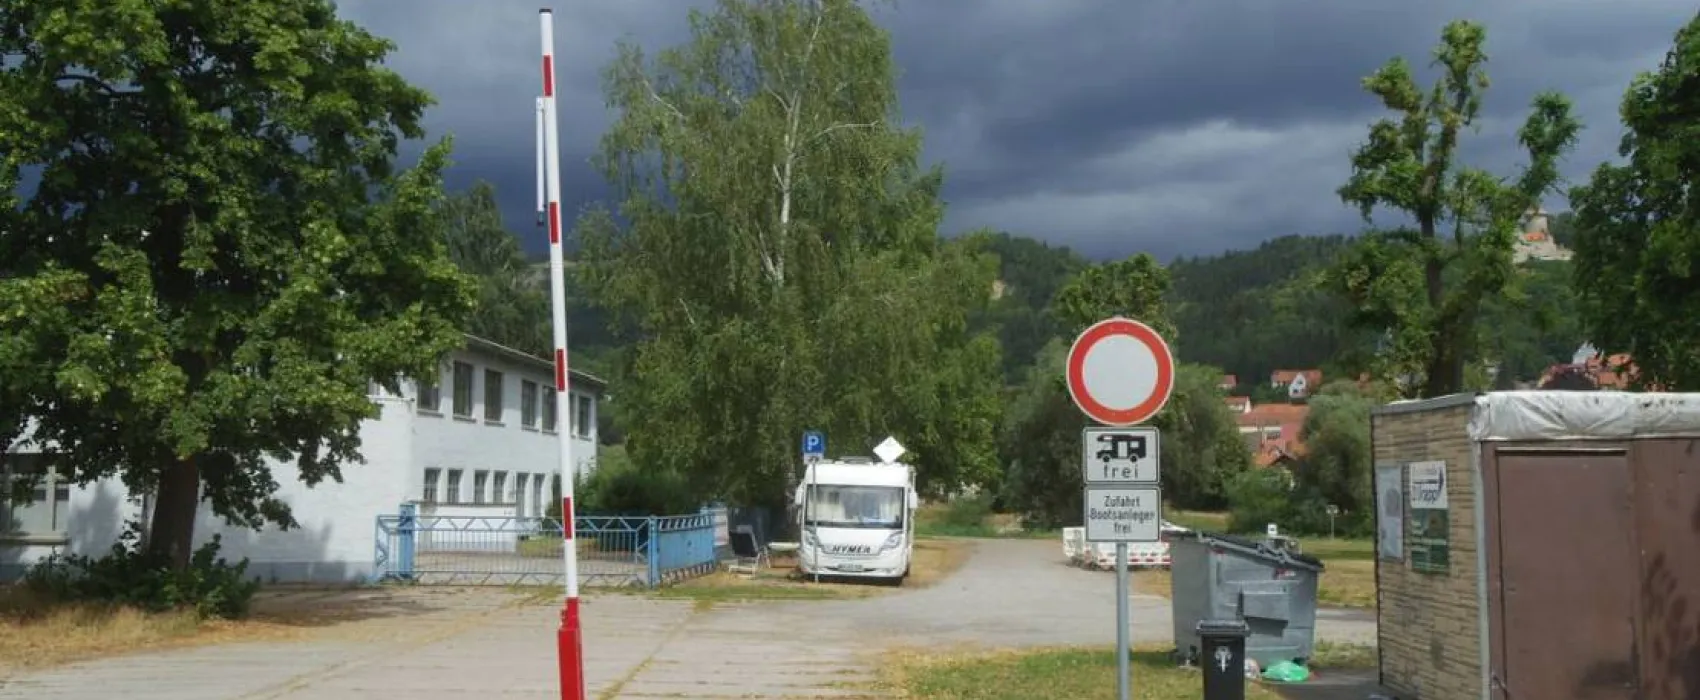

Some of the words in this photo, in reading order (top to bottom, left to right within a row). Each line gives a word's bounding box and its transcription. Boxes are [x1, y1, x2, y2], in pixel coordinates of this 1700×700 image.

[808, 435, 819, 451] P
[1103, 464, 1138, 478] frei
[1104, 496, 1140, 507] Zufahrt
[1090, 508, 1155, 523] Bootsanleger
[1114, 522, 1131, 533] frei
[832, 545, 871, 553] HYMER
